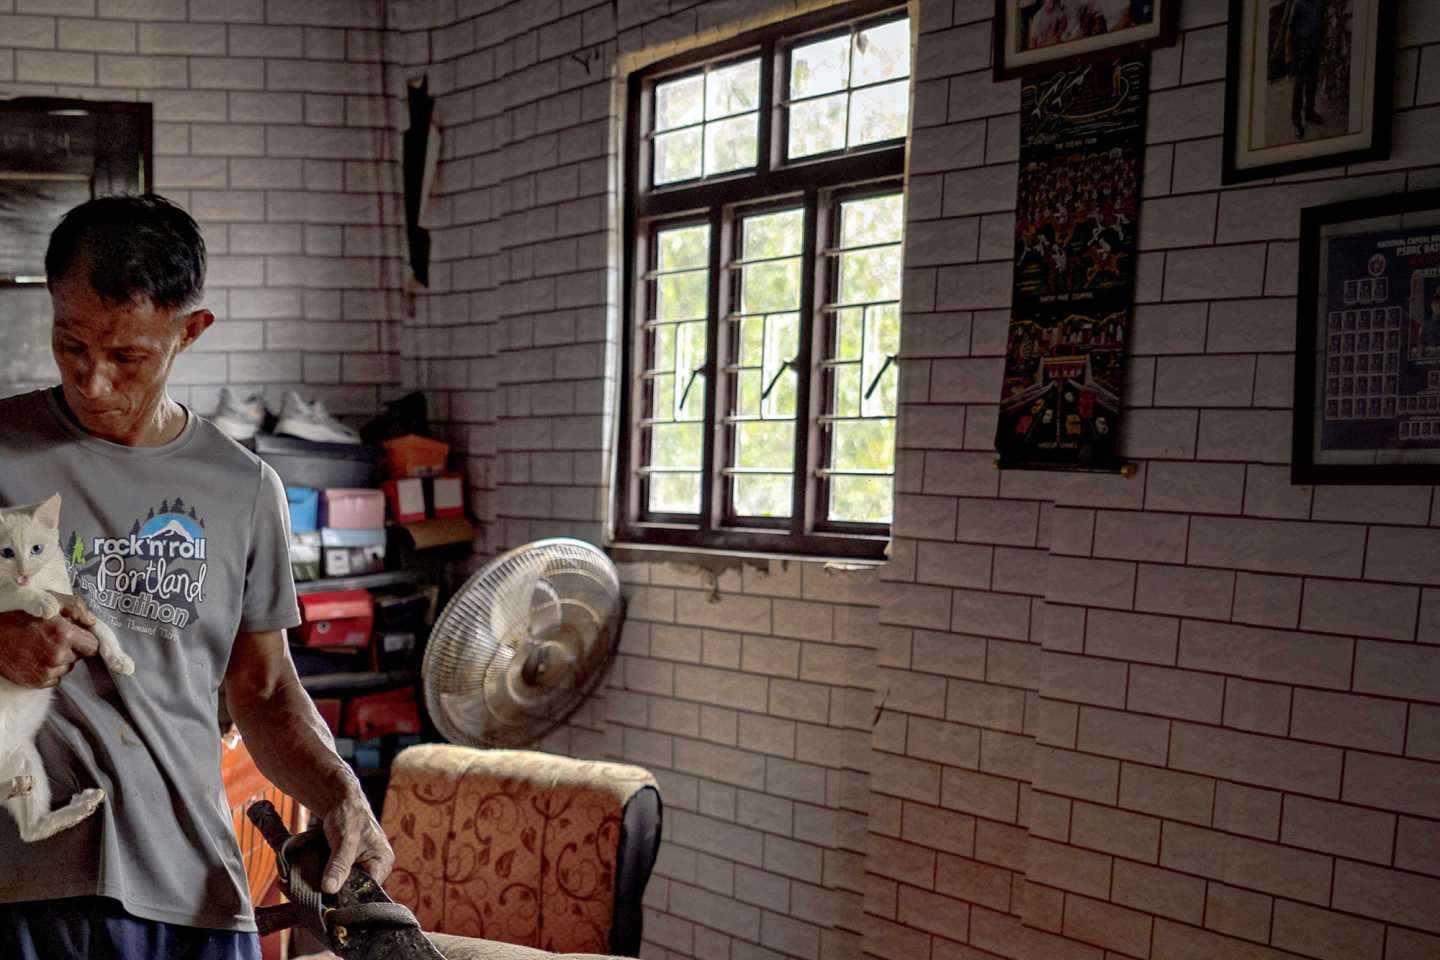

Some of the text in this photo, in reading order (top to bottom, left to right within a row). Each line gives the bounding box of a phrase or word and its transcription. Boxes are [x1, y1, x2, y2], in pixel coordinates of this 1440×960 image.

[94, 534, 143, 556] rock
[169, 538, 206, 559] roll
[97, 553, 207, 603] Portland
